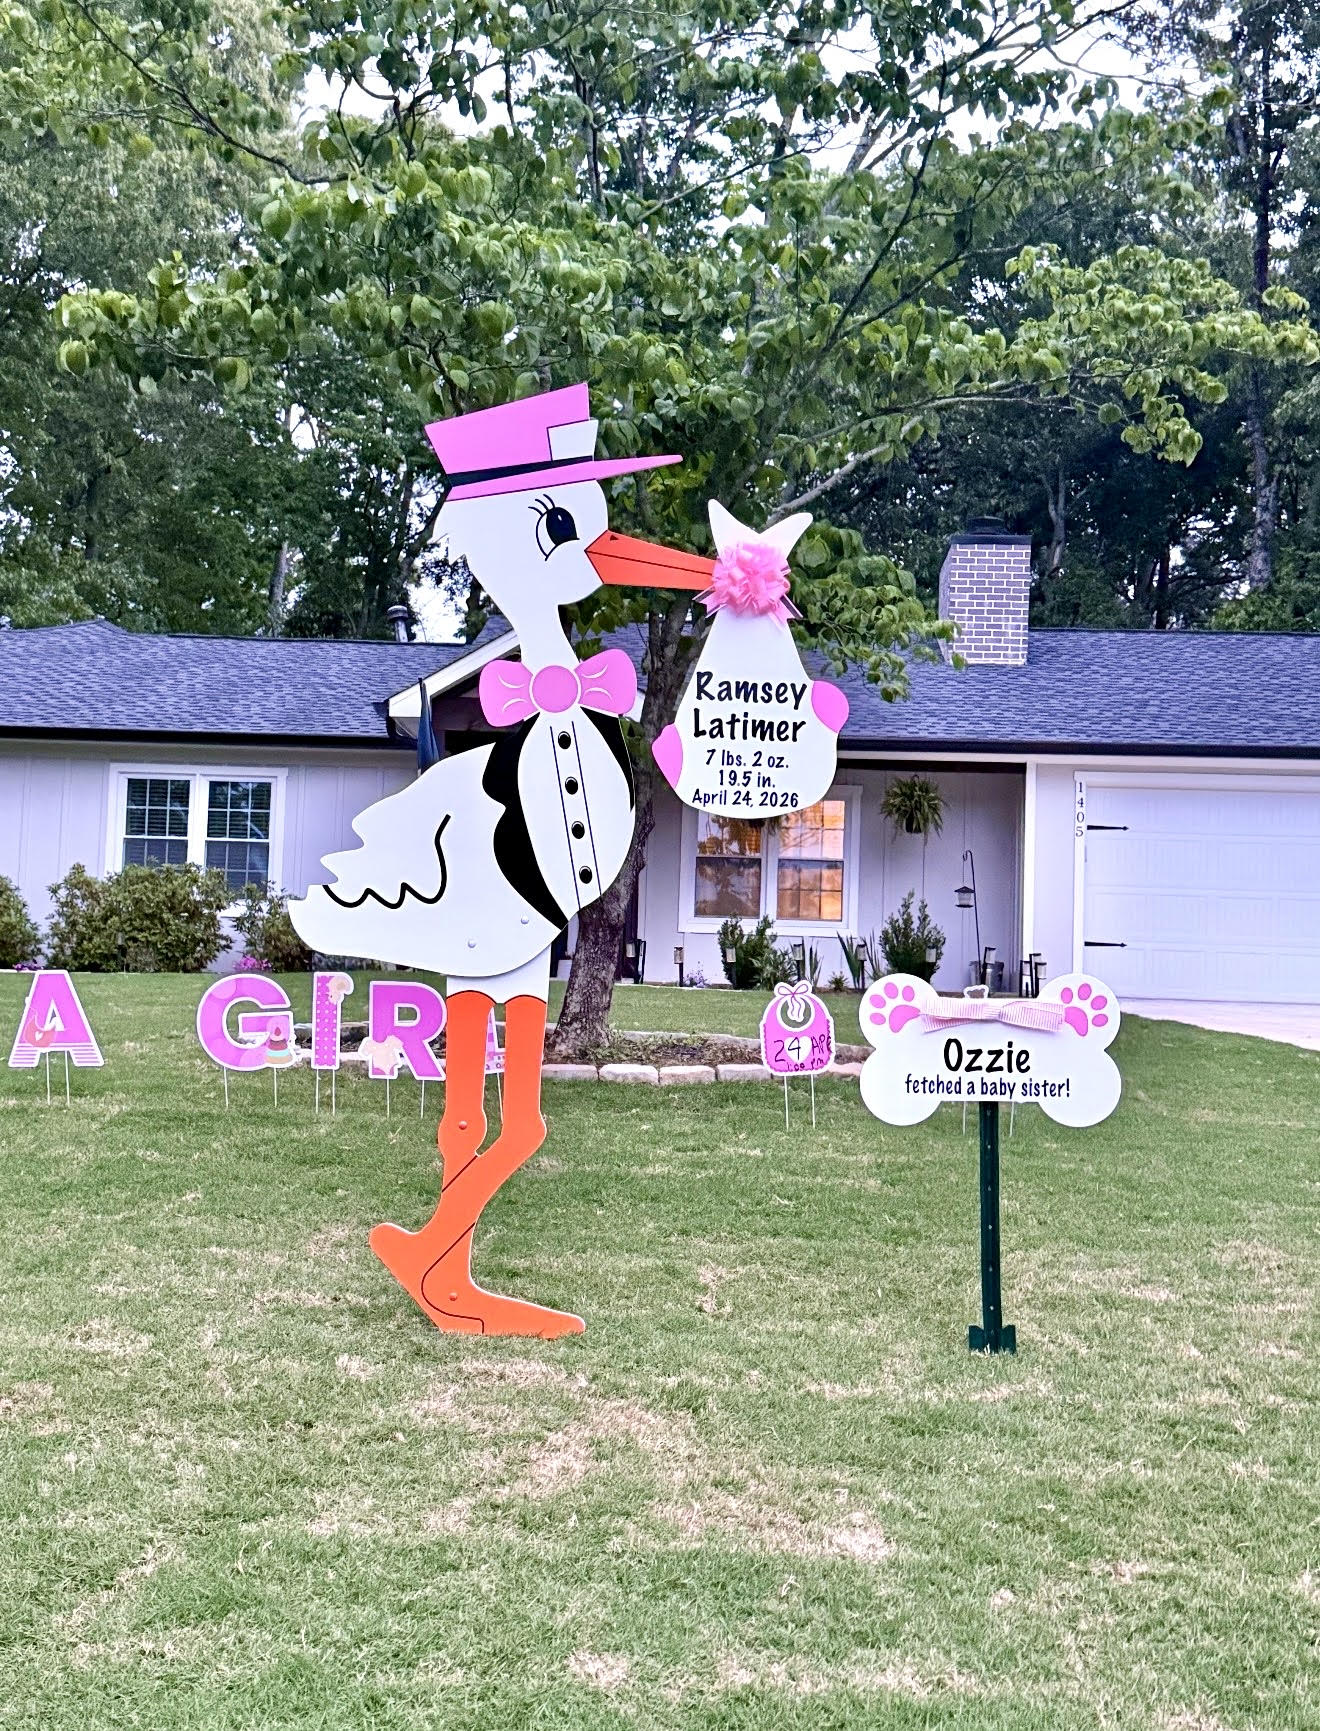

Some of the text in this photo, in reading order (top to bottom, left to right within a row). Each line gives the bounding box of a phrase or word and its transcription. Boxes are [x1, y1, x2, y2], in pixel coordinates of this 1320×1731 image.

[696, 671, 807, 710] Ramsey
[694, 708, 806, 742] Latimer
[706, 749, 789, 768] 7 lbs. 2 oz.
[719, 770, 776, 788] 19.5 in.
[692, 789, 799, 808] April 24, 2026
[1075, 782, 1085, 838] 1405
[8, 970, 104, 1068] A
[774, 1036, 801, 1062] 24
[944, 1038, 1031, 1074] Ozzie
[905, 1074, 1070, 1099] fetched a baby sister!
